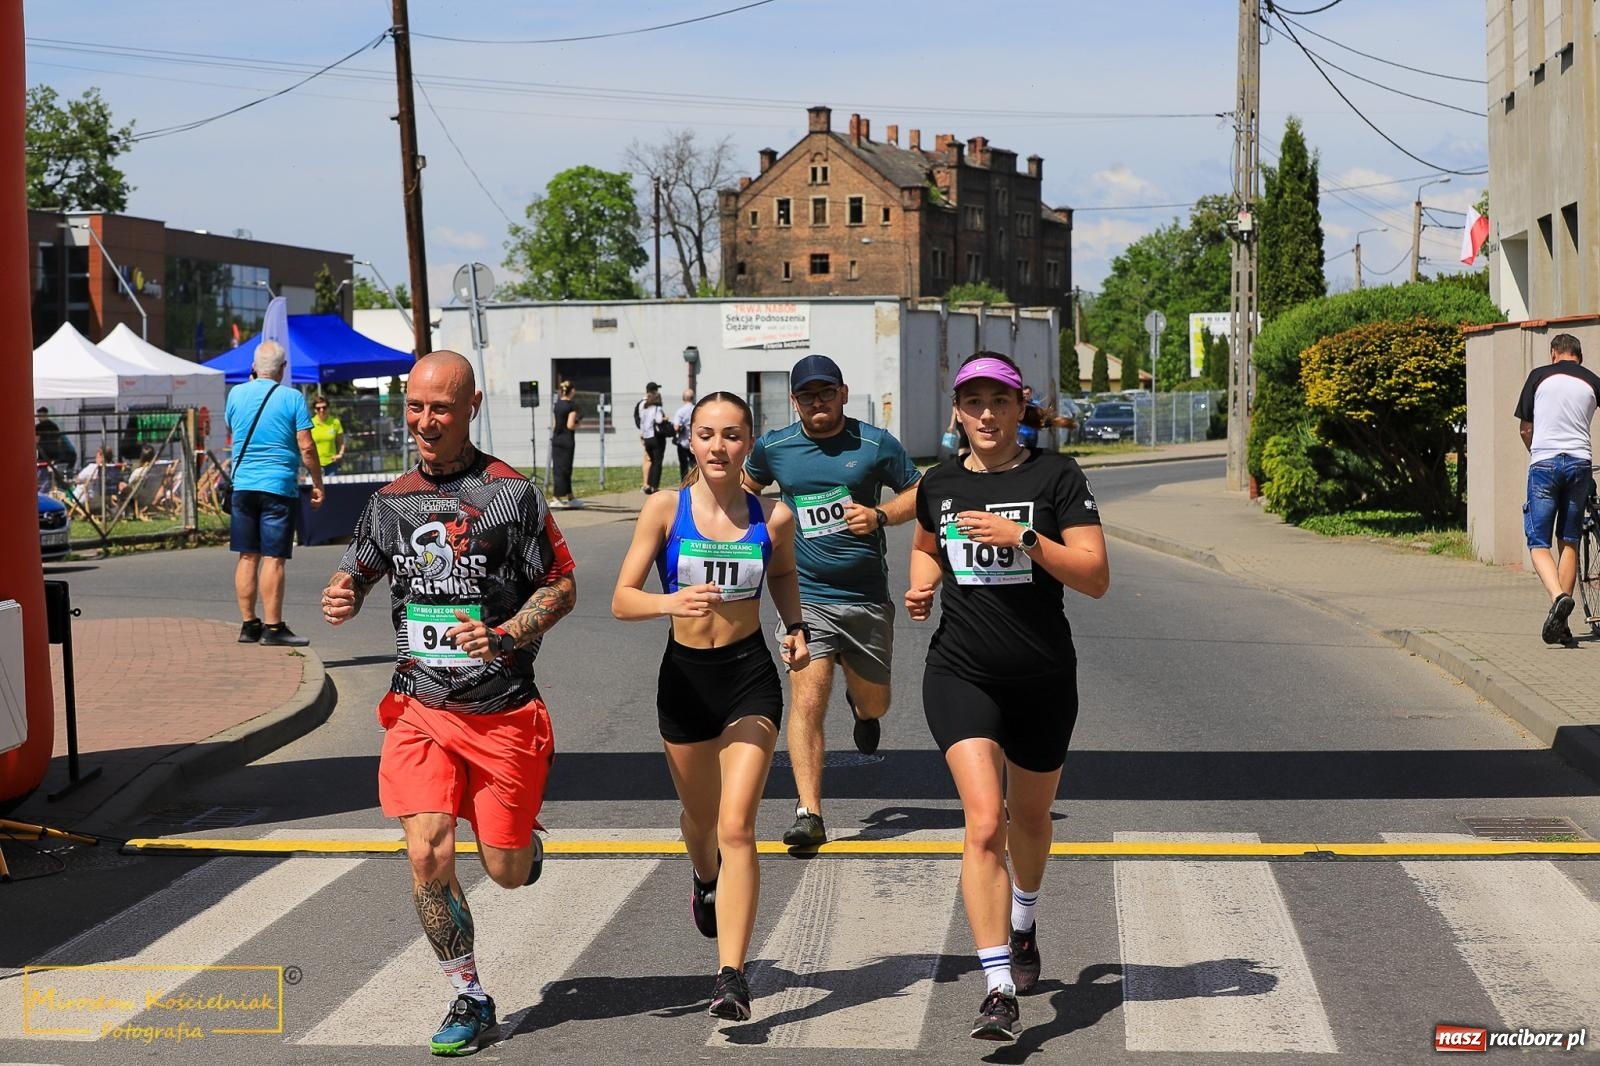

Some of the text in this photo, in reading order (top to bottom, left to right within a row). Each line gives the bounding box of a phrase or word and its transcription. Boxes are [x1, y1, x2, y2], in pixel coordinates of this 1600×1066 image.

[726, 314, 806, 323] Sekcja Podnoszenia
[807, 502, 844, 526] 100
[717, 543, 729, 551] BEZ
[962, 543, 1014, 568] 109
[703, 560, 739, 586] 111
[422, 624, 458, 651] 94
